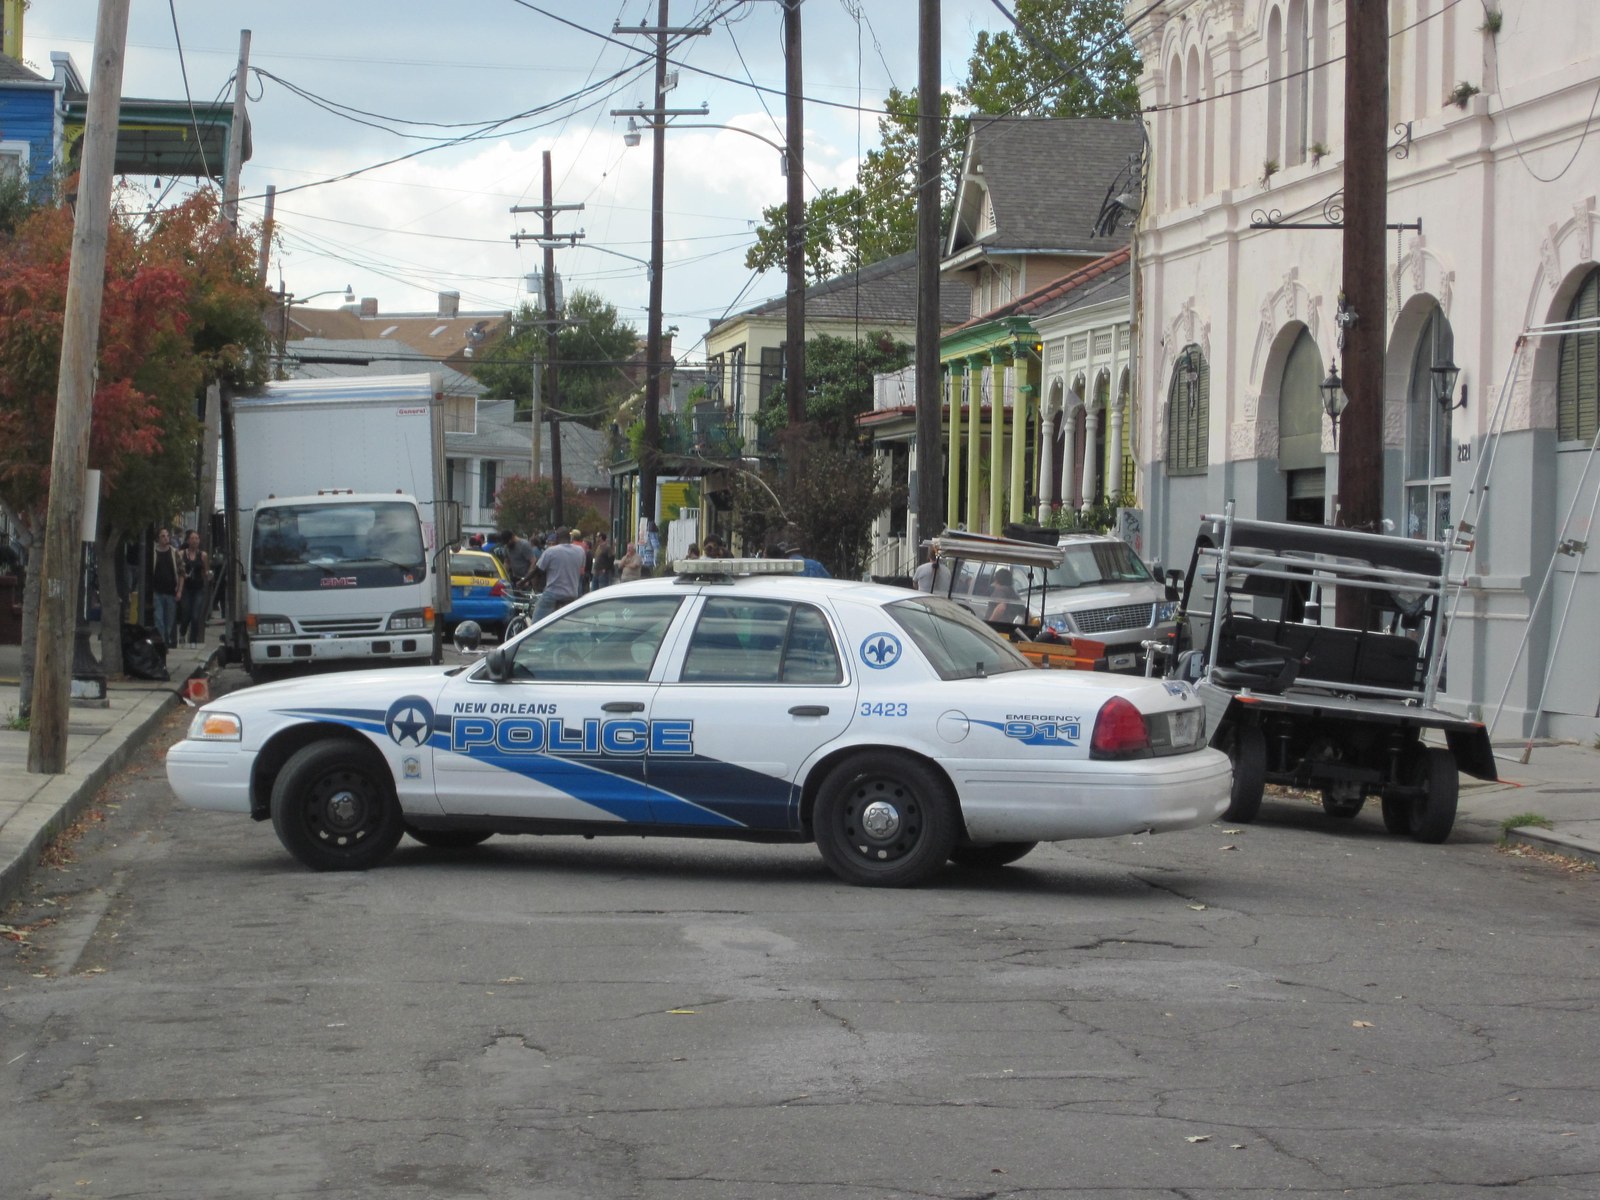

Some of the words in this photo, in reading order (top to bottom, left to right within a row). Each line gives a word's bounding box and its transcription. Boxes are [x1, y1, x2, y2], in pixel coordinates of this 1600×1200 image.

[320, 576, 357, 587] GMC
[453, 702, 487, 714] NEW
[490, 703, 557, 715] ORLEANS
[860, 702, 908, 717] 3423
[1005, 714, 1081, 722] EMERGENCY
[451, 716, 696, 757] POLICE
[1004, 720, 1081, 740] 911
